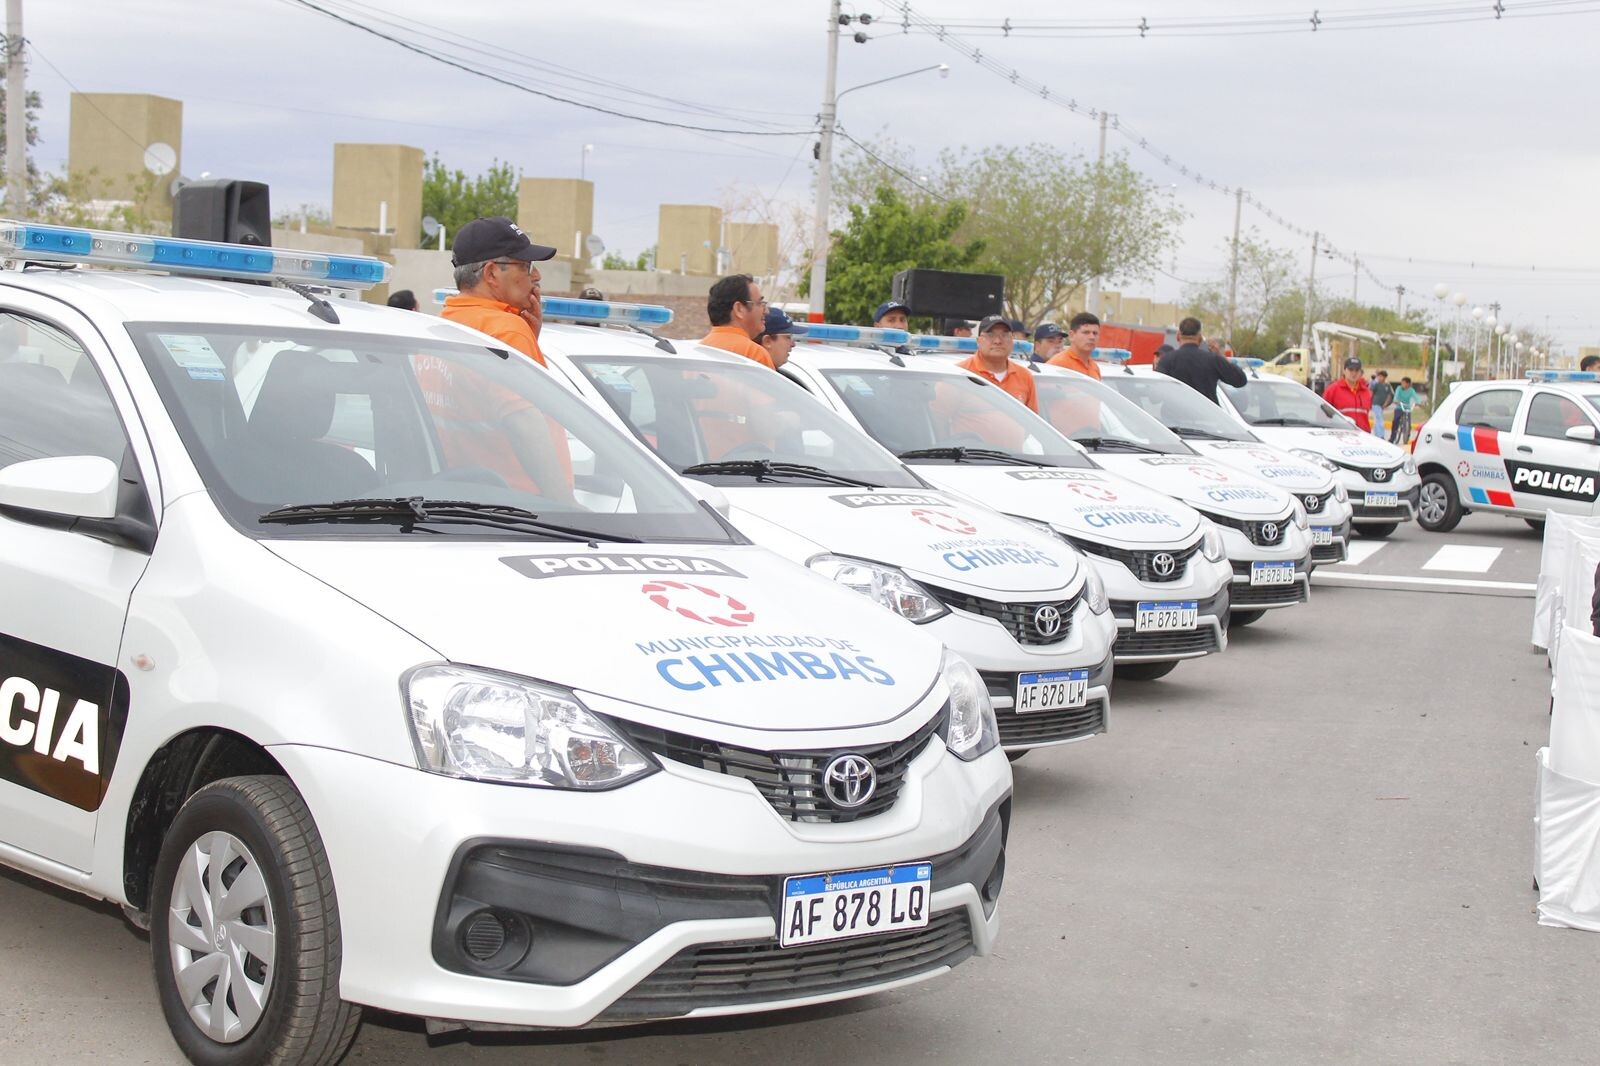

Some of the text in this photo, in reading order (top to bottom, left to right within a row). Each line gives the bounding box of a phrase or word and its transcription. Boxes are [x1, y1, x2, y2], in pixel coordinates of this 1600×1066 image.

[1018, 471, 1102, 480] POLICIA
[1472, 468, 1505, 481] CHIMBAS
[1514, 467, 1595, 495] POLICIA
[845, 494, 950, 506] POLICIA
[1084, 511, 1181, 527] CHIMBAS
[529, 556, 729, 574] POLICIA
[942, 548, 1060, 572] CHIMBAS
[1254, 568, 1293, 583] AF 878 LS
[1140, 610, 1195, 629] AF 878 LV
[634, 635, 861, 656] MUNICIPALIDAD DE
[656, 651, 896, 691] CHIMBAS
[1020, 681, 1085, 709] AF 878 LW
[825, 876, 892, 892] REPÚBLICA ARGENTINA
[789, 885, 924, 938] AF 878 LQ
